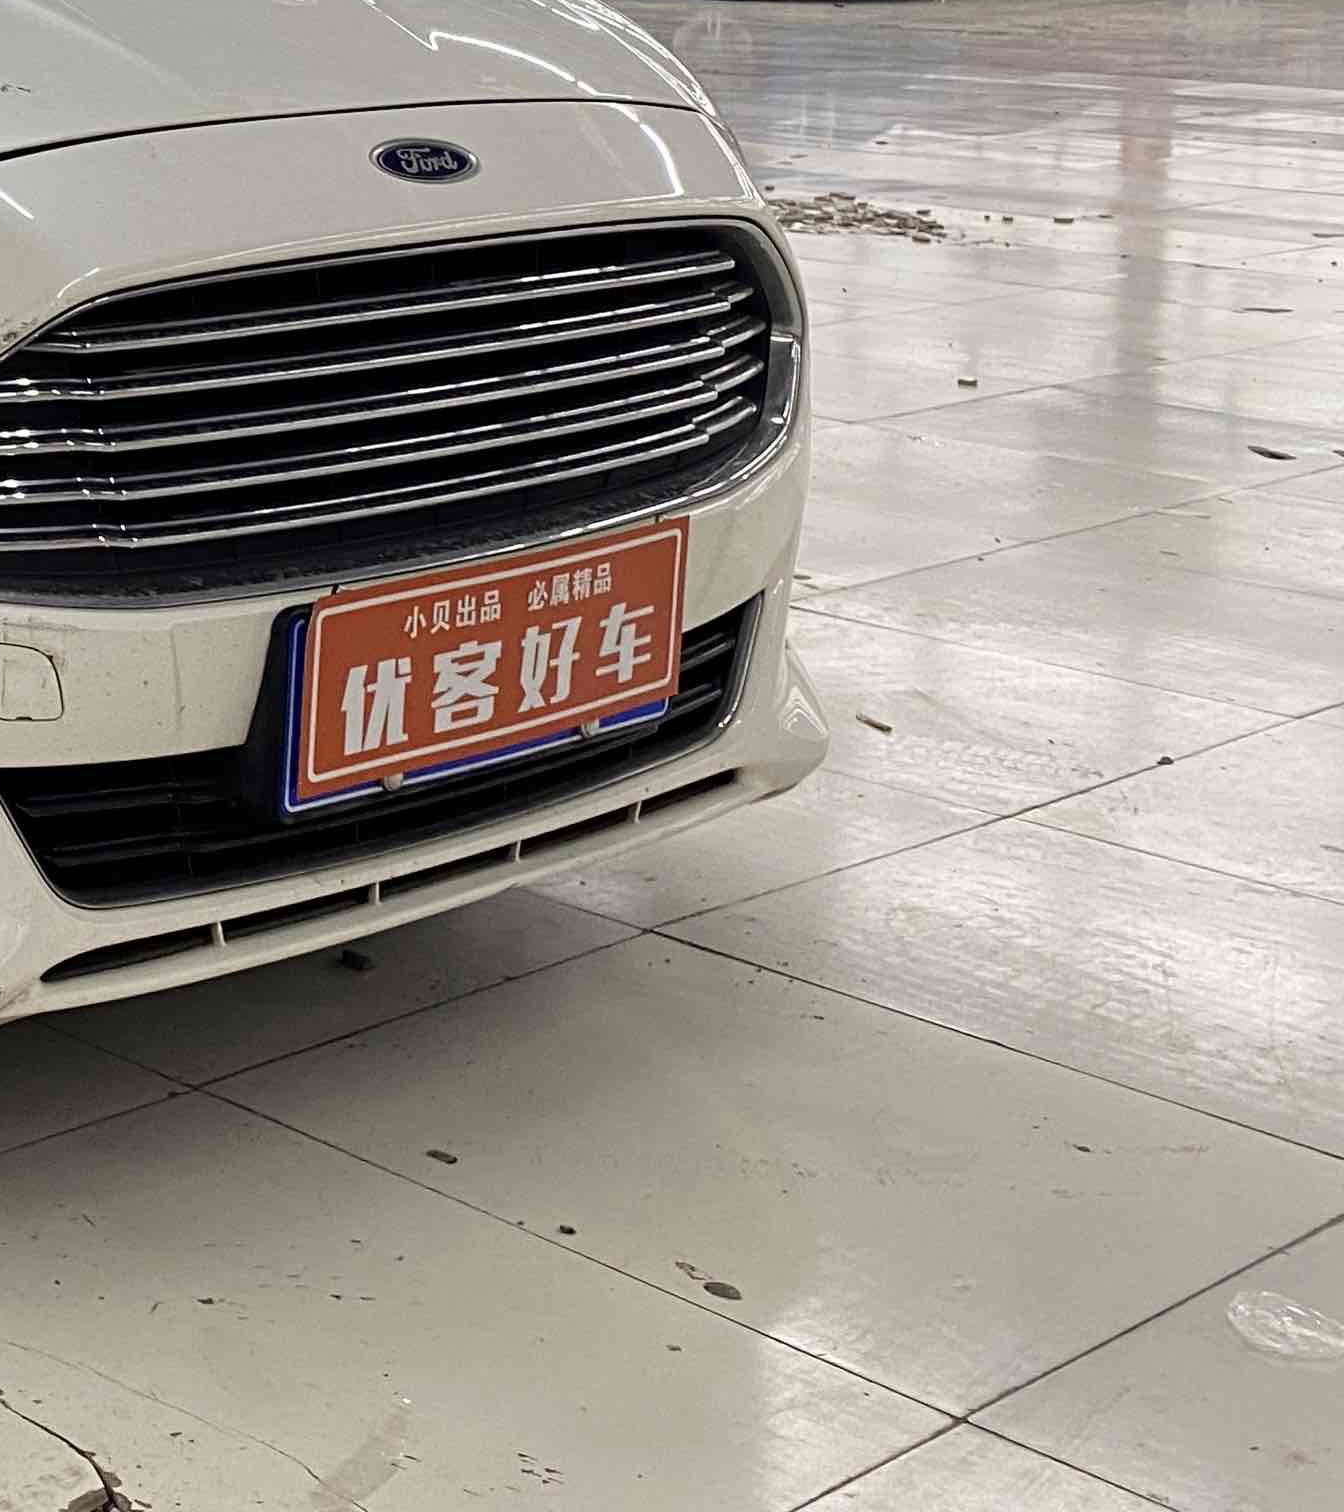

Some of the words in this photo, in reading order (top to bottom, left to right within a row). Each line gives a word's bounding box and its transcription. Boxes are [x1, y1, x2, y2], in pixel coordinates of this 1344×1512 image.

[397, 147, 459, 175] Ford
[405, 590, 502, 640] 小贝出品
[527, 562, 613, 612] 必属精品
[340, 602, 656, 756] 优客好车
